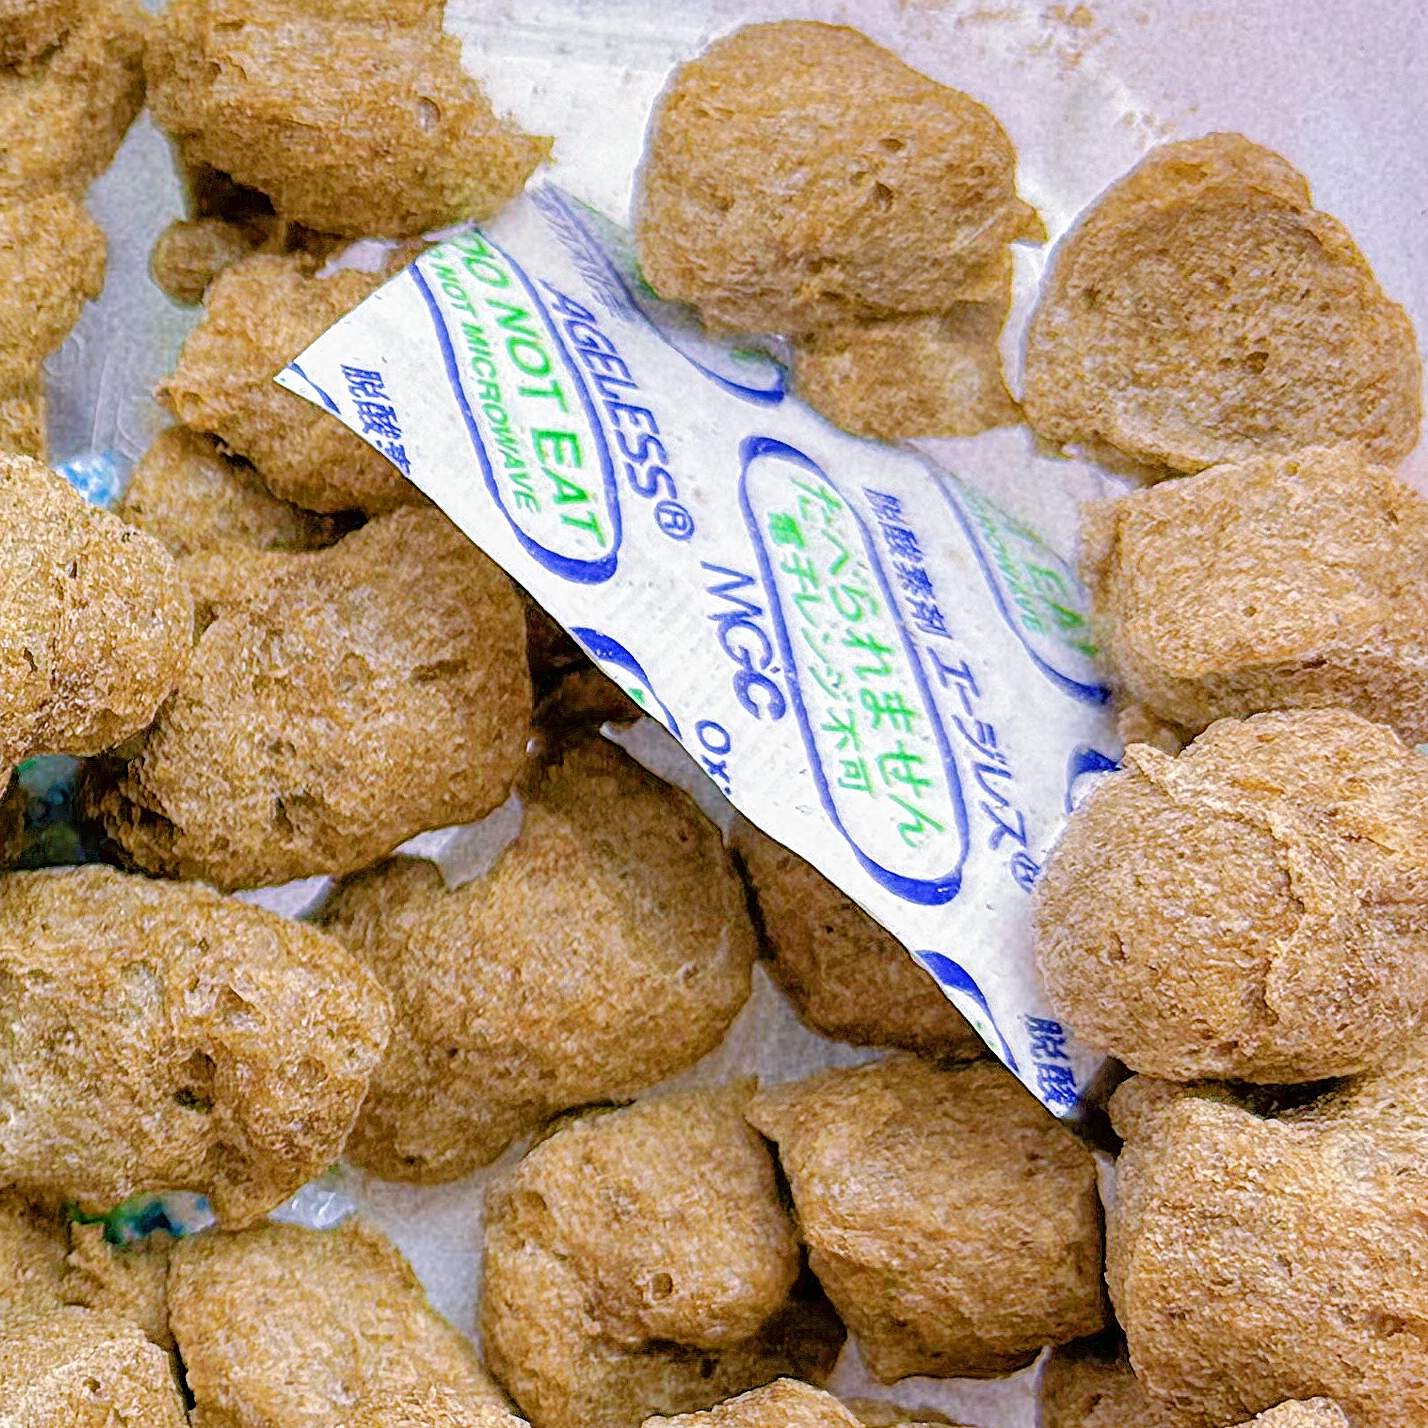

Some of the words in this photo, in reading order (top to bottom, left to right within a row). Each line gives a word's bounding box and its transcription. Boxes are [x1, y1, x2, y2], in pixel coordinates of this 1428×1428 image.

[460, 319, 543, 516] MICROWAVE
[484, 297, 570, 414] NOT
[530, 426, 608, 549] EAT
[790, 475, 946, 850] たべられません
